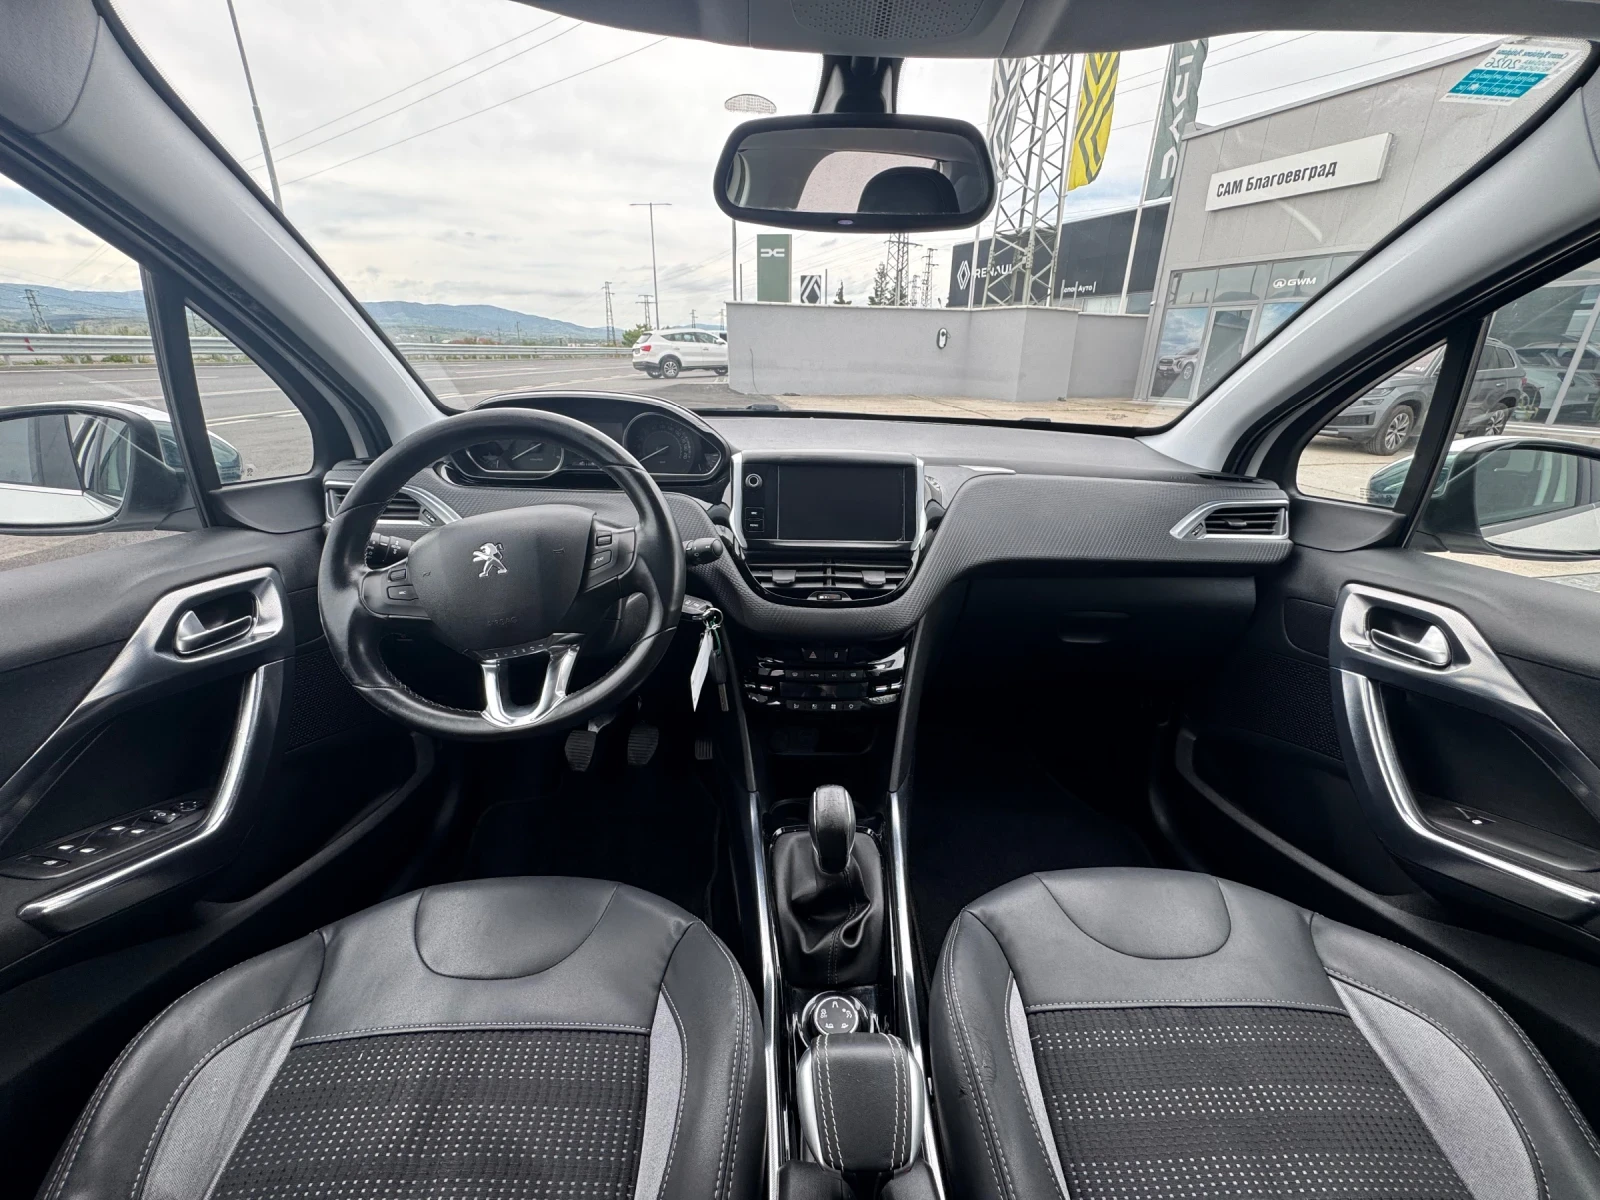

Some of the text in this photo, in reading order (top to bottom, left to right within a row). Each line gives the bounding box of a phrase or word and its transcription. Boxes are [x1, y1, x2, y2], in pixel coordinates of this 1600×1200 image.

[1160, 40, 1197, 180] DACI
[1216, 161, 1338, 198] САМ Благоевград
[974, 263, 1013, 279] RENAUL
[1287, 276, 1317, 287] GWM
